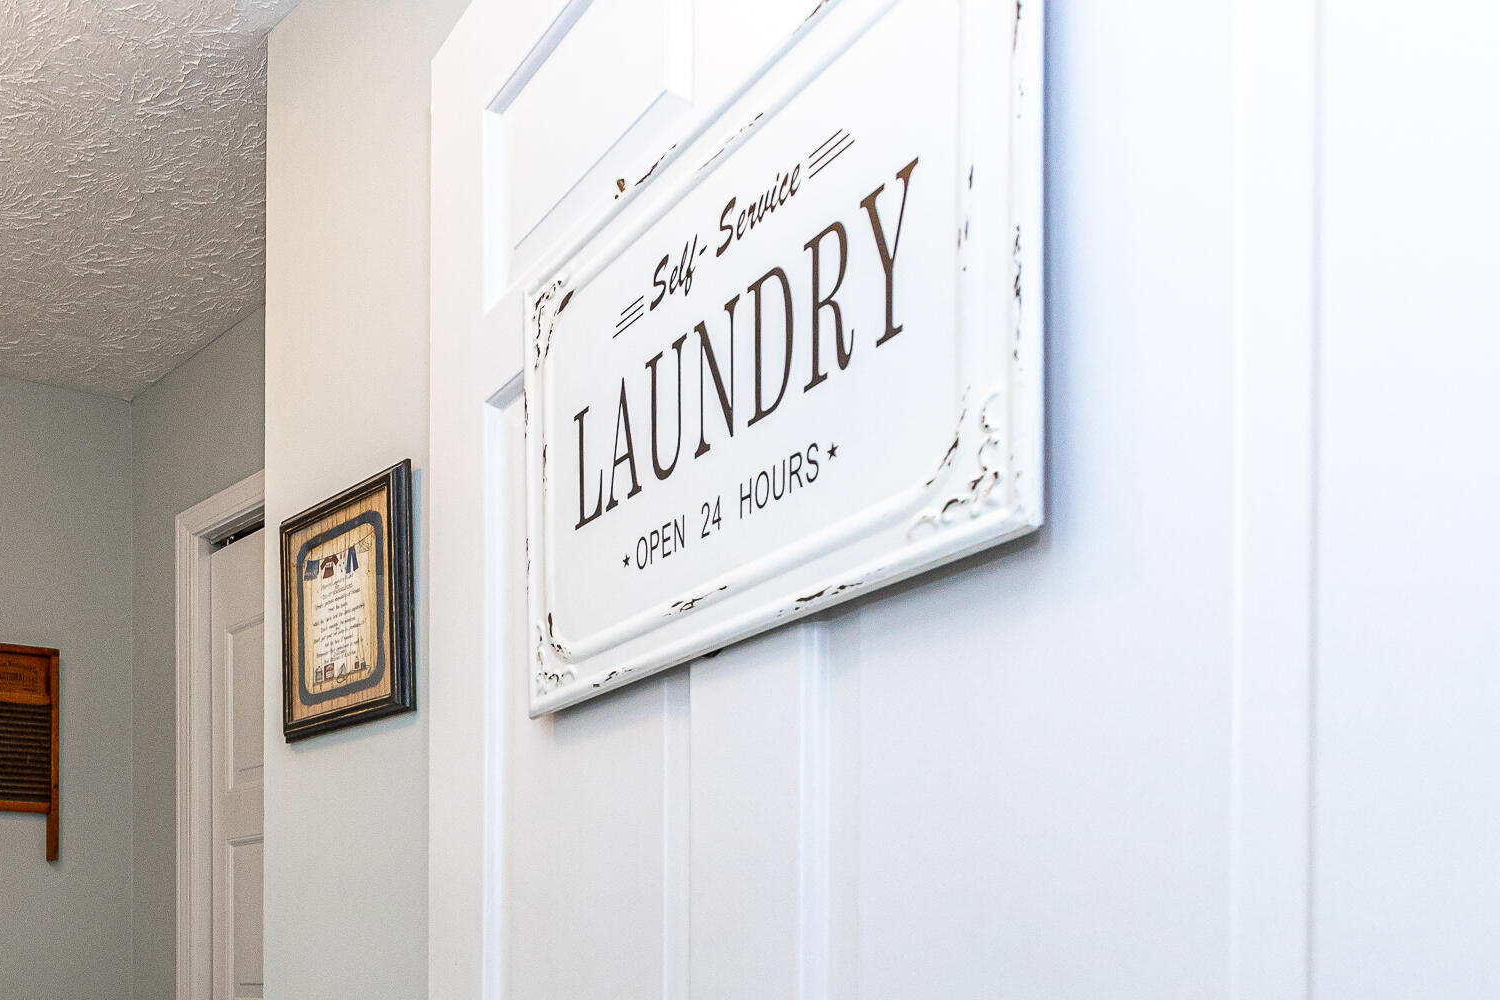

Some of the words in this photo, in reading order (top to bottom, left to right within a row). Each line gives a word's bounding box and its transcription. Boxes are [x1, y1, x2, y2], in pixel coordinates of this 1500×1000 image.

[649, 233, 708, 311] Self-
[715, 163, 801, 258] Service
[573, 156, 919, 531] LAUNDRY
[636, 514, 685, 570] OPEN
[700, 495, 722, 539] 24
[739, 442, 820, 520] HOURS
